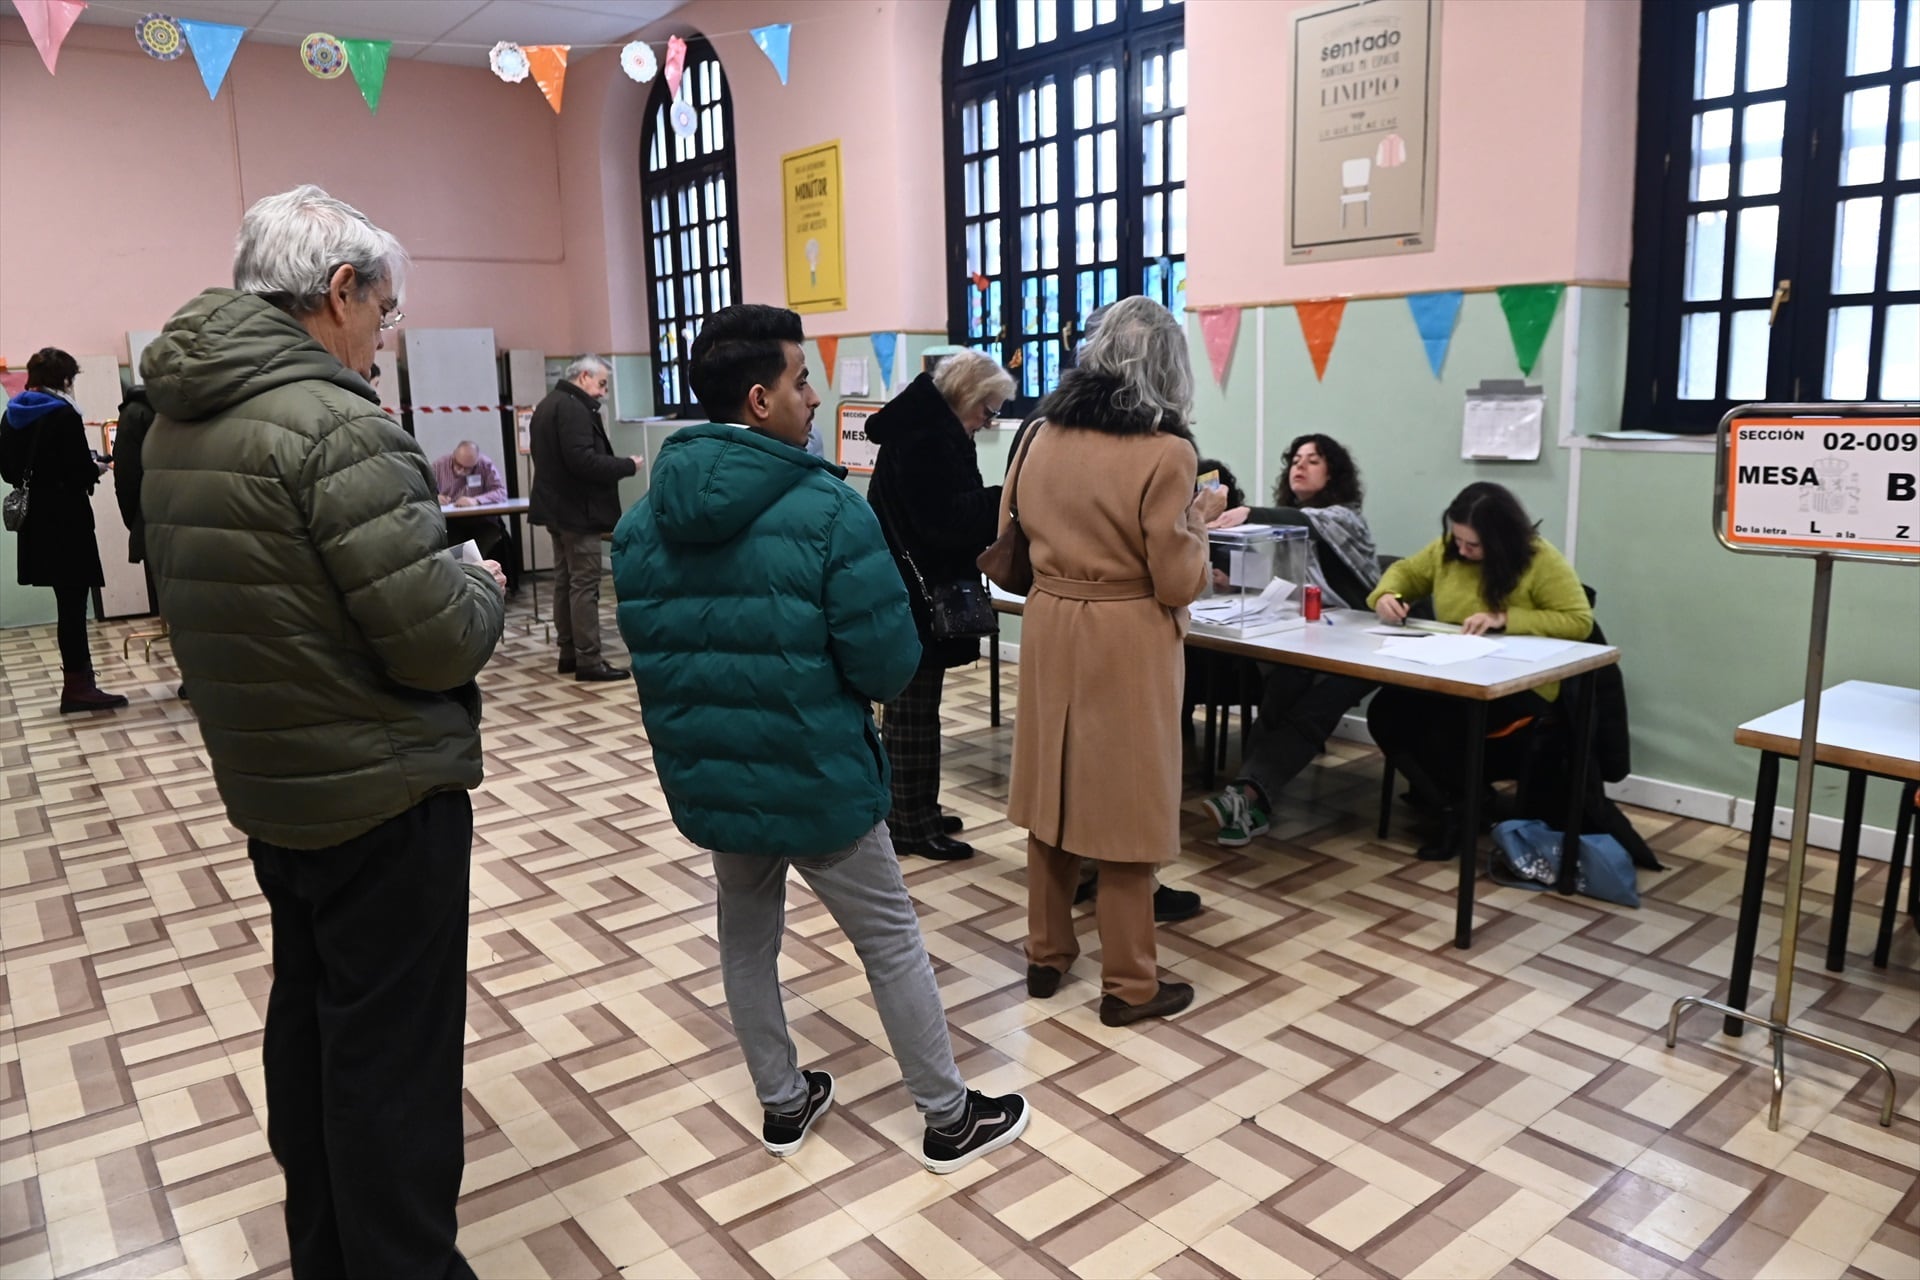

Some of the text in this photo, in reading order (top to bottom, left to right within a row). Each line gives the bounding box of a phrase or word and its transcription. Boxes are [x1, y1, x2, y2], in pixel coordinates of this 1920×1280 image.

[1321, 29, 1401, 62] sentado
[1321, 75, 1399, 107] LIMPIO
[795, 177, 827, 202] MONITOR
[842, 430, 869, 441] MES
[1739, 428, 1918, 452] SECCIÓN 02-009
[1738, 465, 1820, 486] MESA
[1887, 473, 1916, 502] B
[1735, 525, 1748, 533] De
[1751, 526, 1760, 534] la
[1763, 527, 1787, 535] letra
[1810, 521, 1821, 534] L
[1895, 525, 1910, 539] Z
